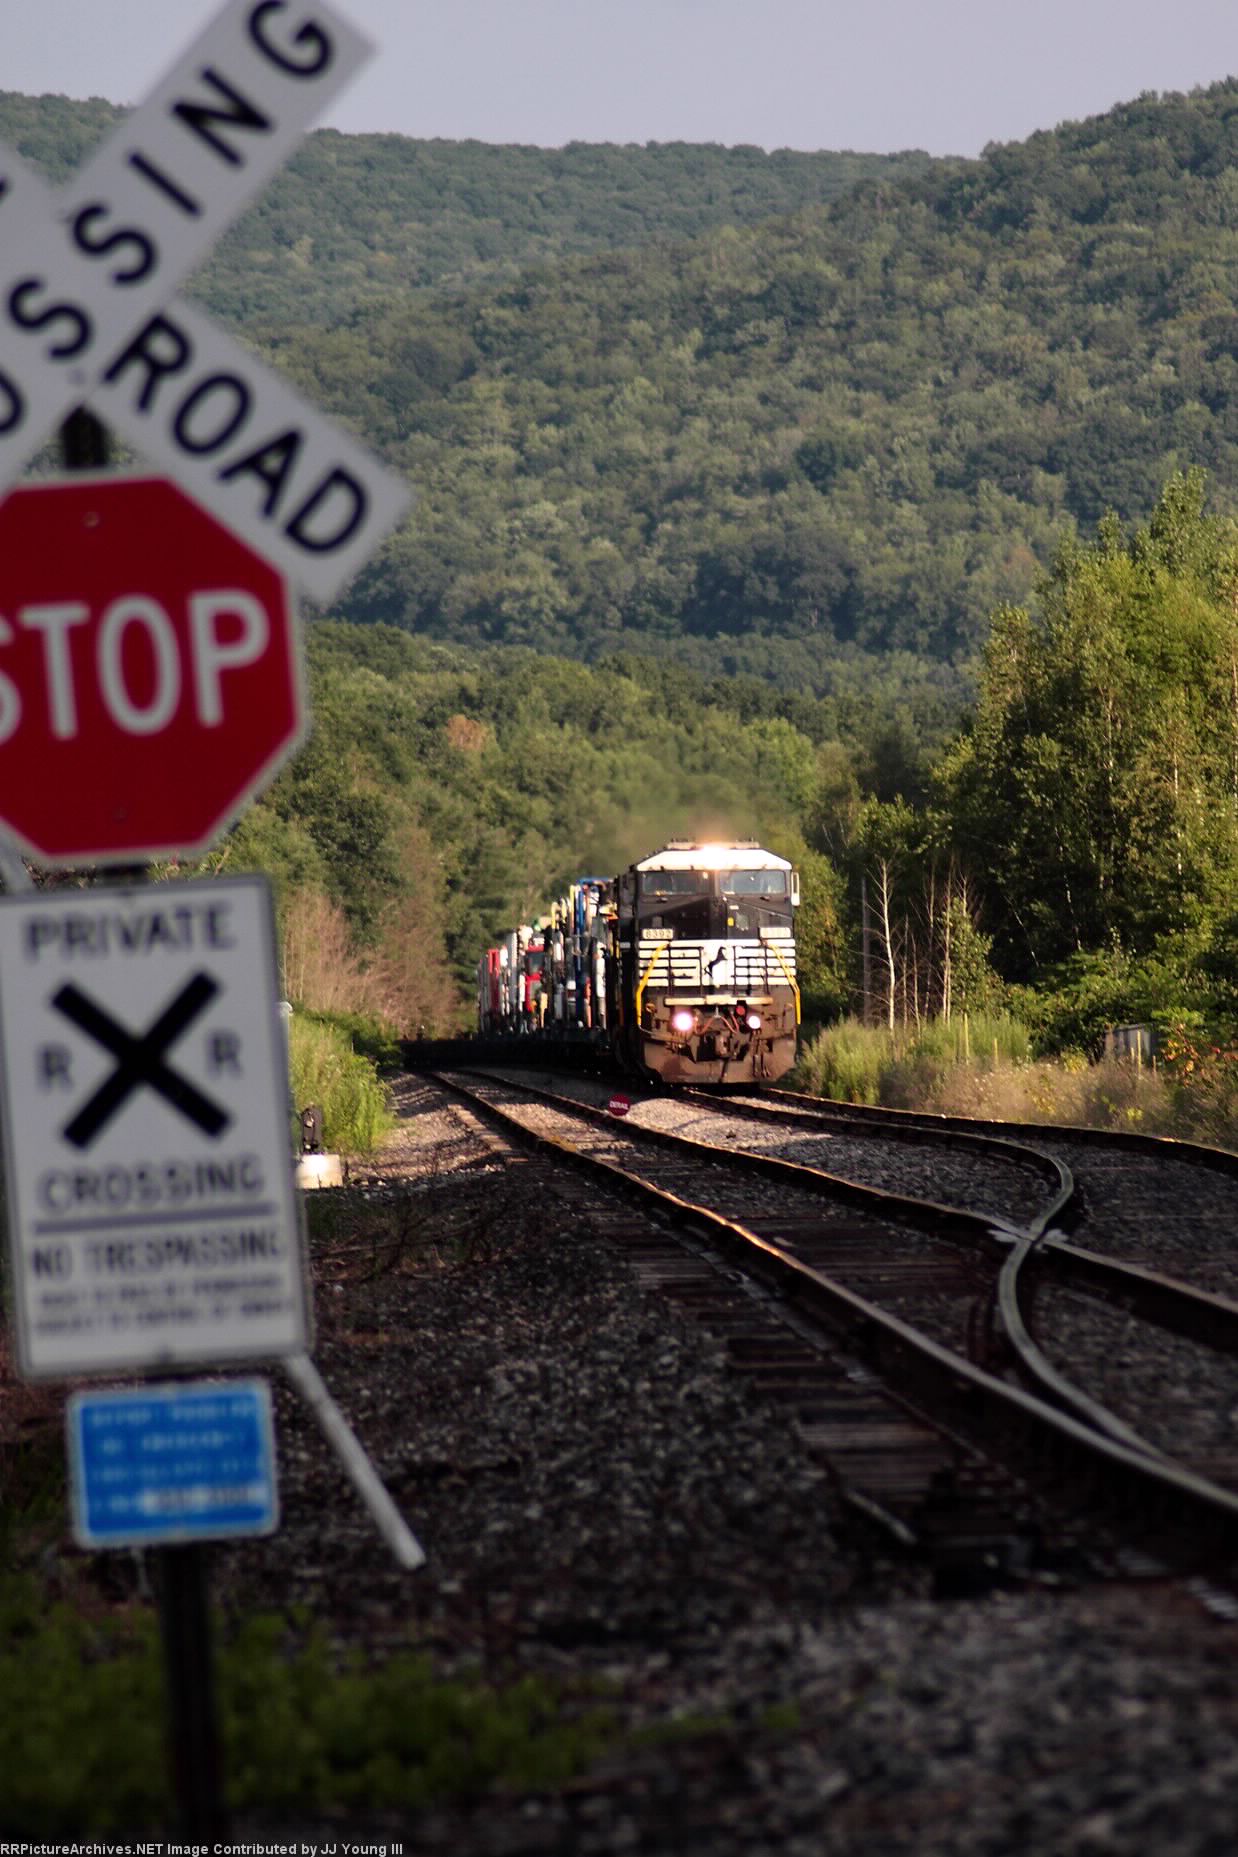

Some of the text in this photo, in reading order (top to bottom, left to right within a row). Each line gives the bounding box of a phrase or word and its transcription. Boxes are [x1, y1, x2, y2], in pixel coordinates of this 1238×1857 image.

[104, 312, 370, 555] ROAD
[25, 902, 237, 962] PRIVATE
[39, 1030, 241, 1090] R R
[41, 1155, 265, 1210] CROSSING
[33, 1230, 282, 1279] NO TRESPASSING
